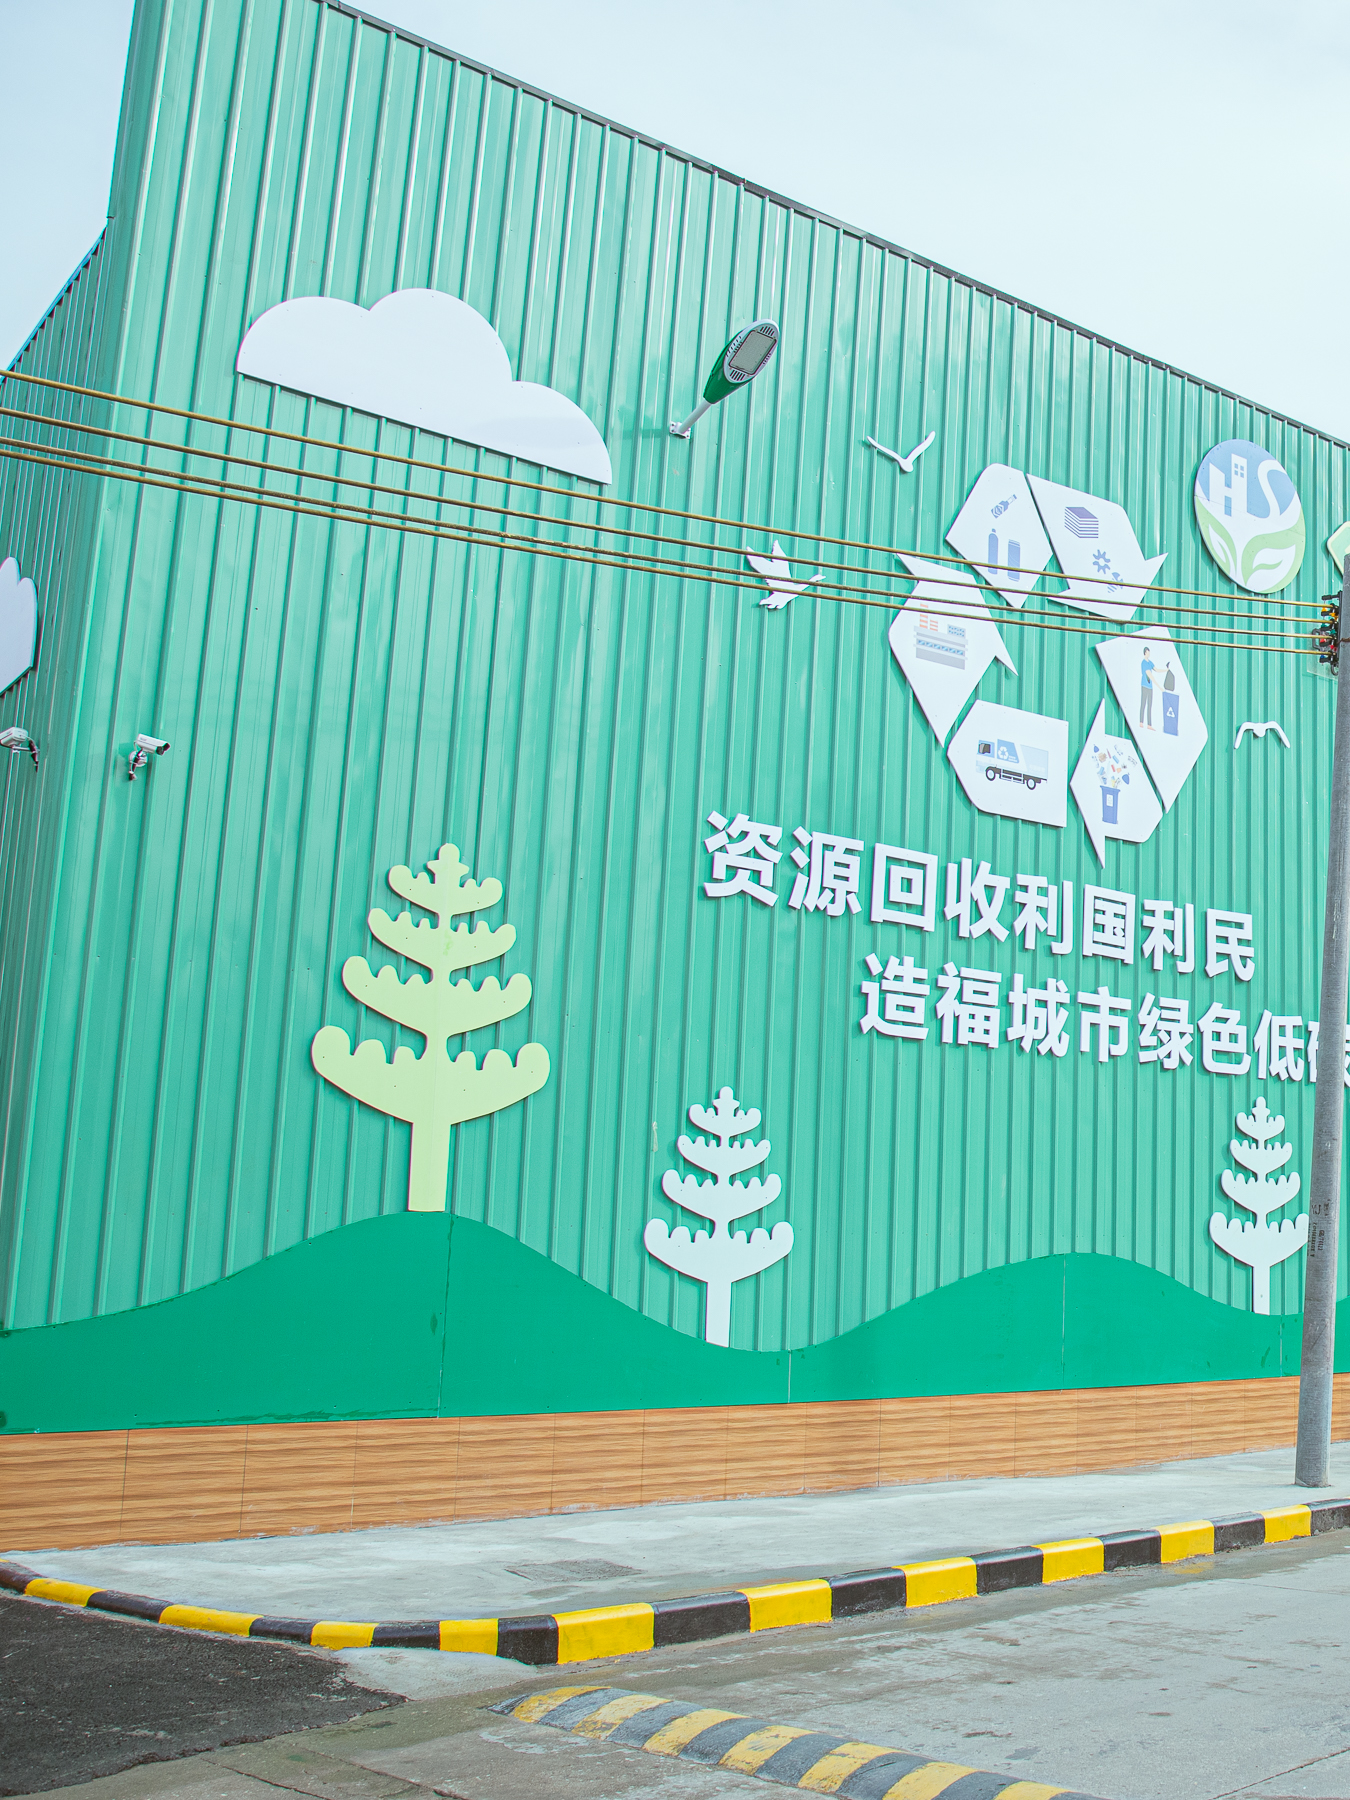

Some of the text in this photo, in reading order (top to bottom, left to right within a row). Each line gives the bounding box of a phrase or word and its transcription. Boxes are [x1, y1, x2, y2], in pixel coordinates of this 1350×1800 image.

[703, 810, 1256, 983] 资源回收利国利民
